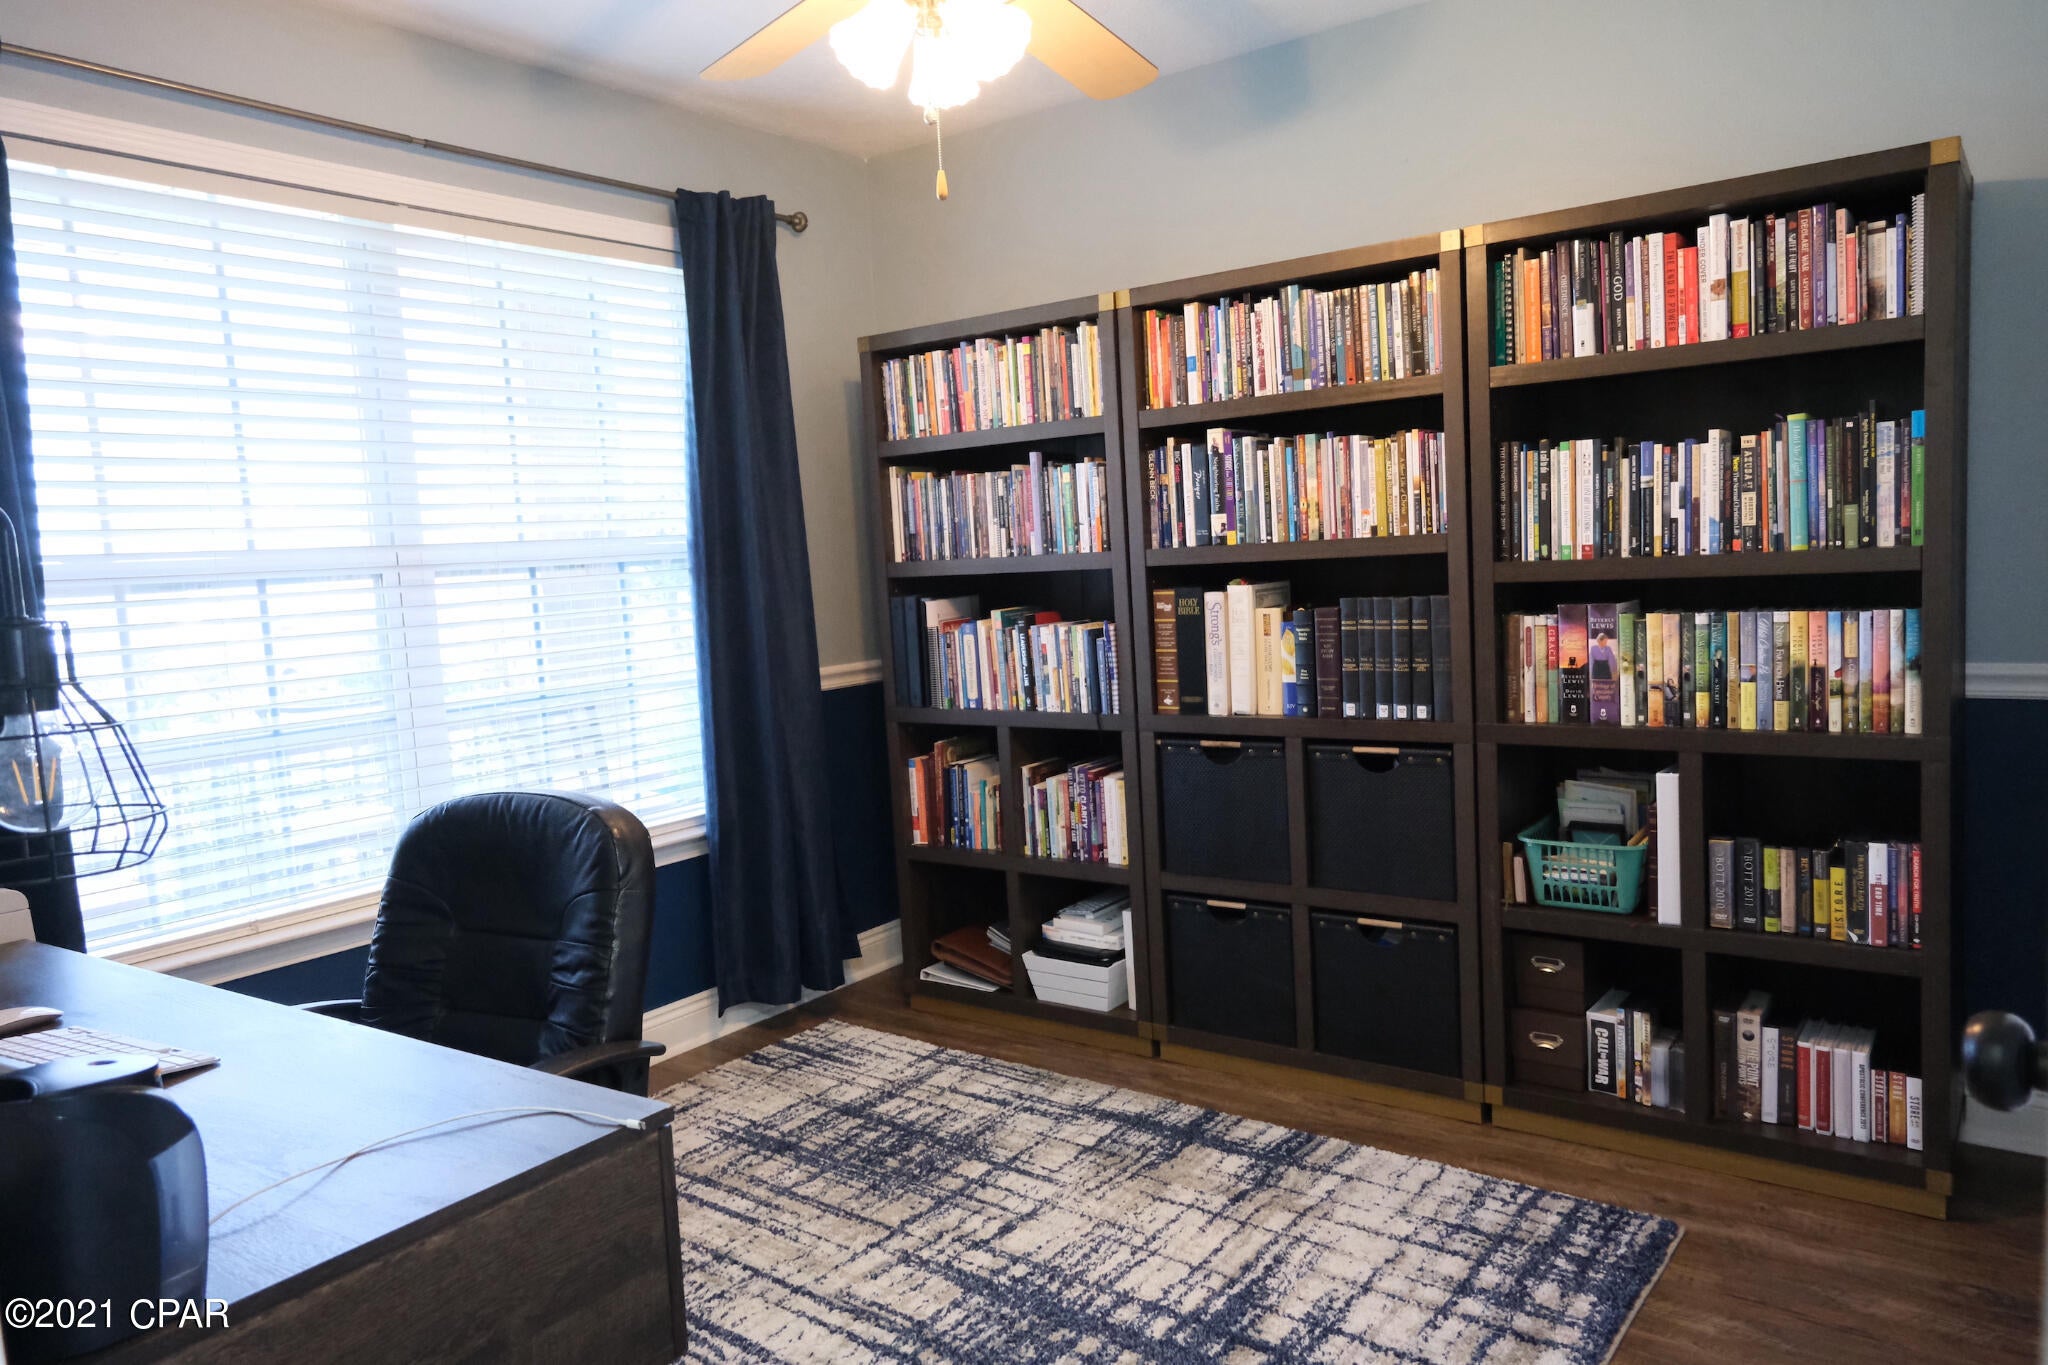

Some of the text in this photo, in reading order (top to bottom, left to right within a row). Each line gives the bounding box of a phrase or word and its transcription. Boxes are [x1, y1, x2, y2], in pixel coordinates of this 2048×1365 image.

[1801, 218, 1810, 253] DECLARE
[1667, 250, 1675, 265] THE
[1801, 254, 1809, 272] WAR
[1560, 275, 1568, 318] OBEDIENCE
[1613, 276, 1623, 301] GOD
[1668, 288, 1676, 298] OF
[1668, 302, 1676, 332] POWER
[1732, 456, 1740, 473] Nee
[1744, 450, 1753, 481] AZUSA
[1193, 471, 1202, 500] Prayer
[1177, 607, 1200, 616] BIBLE
[1179, 598, 1198, 607] HOLY
[1205, 601, 1223, 647] Strong's
[1775, 625, 1785, 647] NEVER
[1729, 656, 1737, 680] Amish
[1776, 648, 1785, 661] FAR
[1776, 680, 1787, 700] HOME
[1080, 795, 1088, 829] CLARITY
[1715, 857, 1725, 909] BOTT 2010
[1744, 856, 1753, 906] BOTT 2011
[1800, 857, 1809, 887] REVIVE
[1874, 873, 1883, 917] THE END TIME
[1594, 1027, 1609, 1085] CALL WAR
[1746, 1062, 1760, 1088] POINT
[1892, 1074, 1904, 1102] STORE
